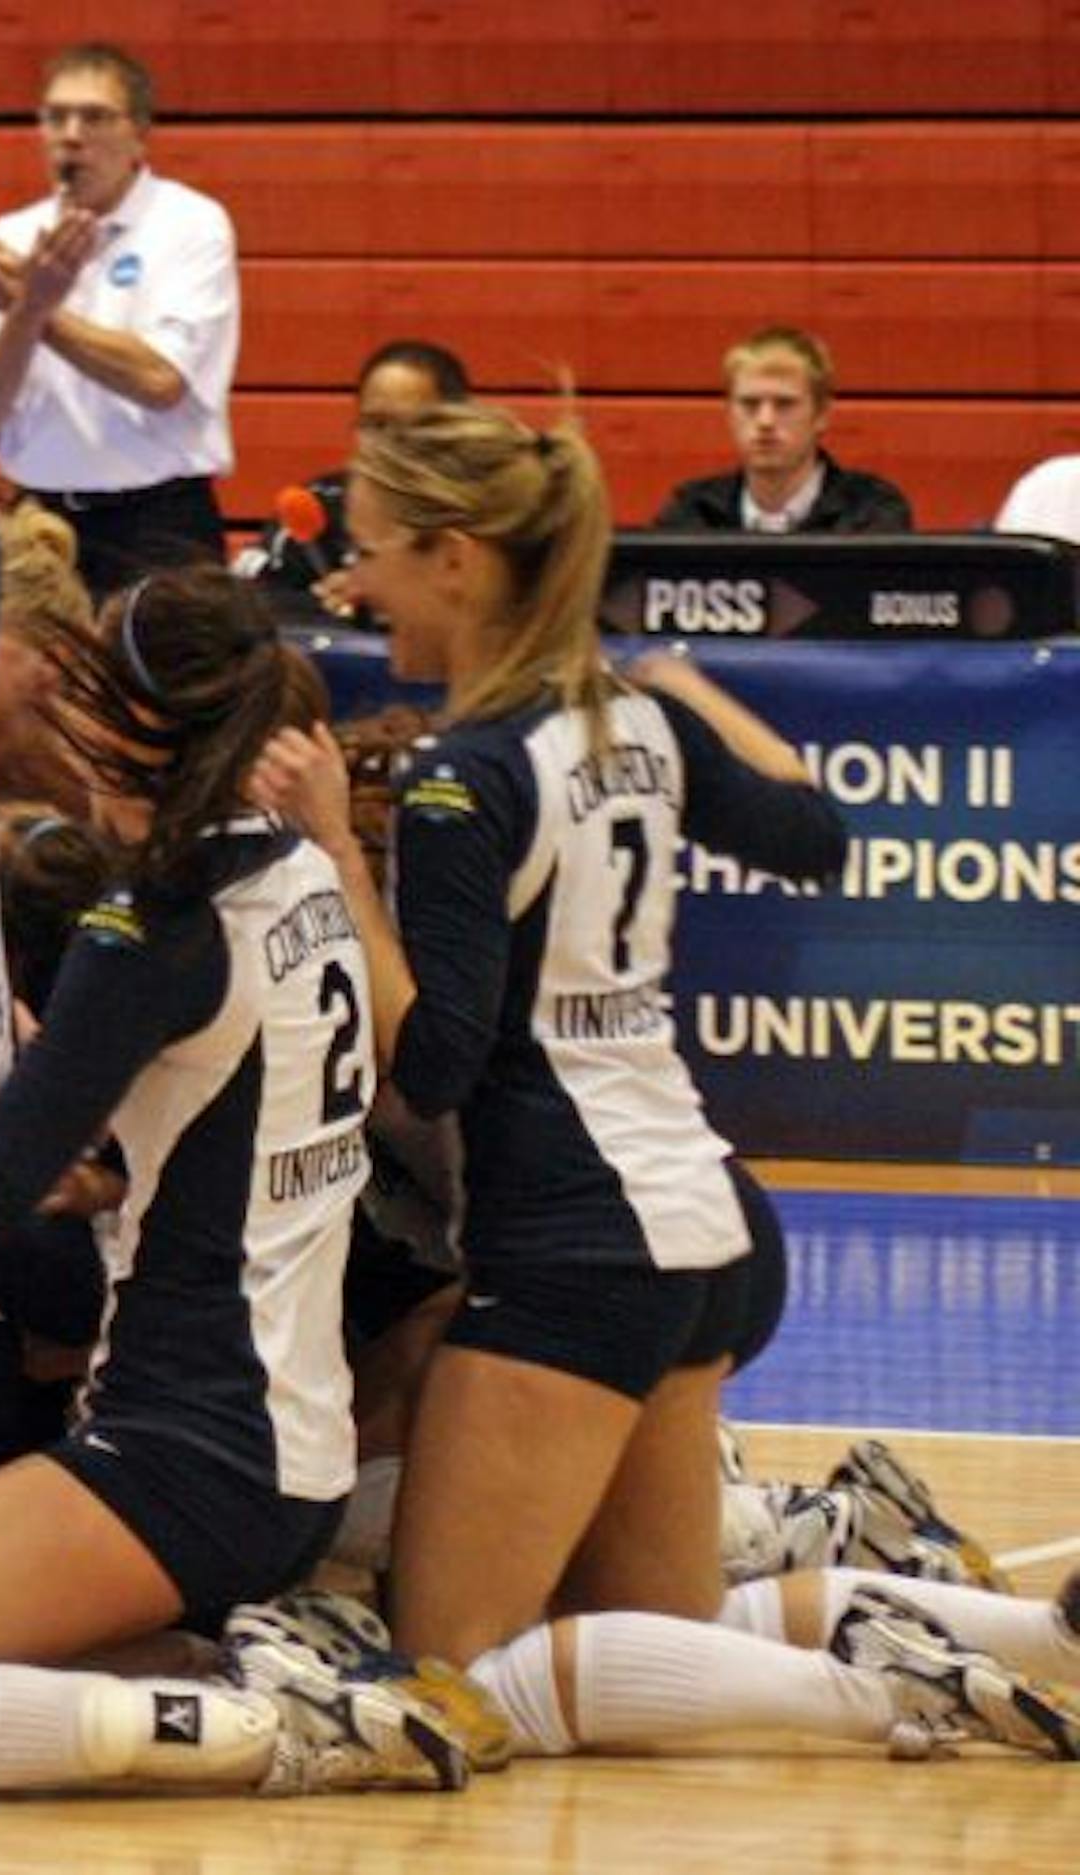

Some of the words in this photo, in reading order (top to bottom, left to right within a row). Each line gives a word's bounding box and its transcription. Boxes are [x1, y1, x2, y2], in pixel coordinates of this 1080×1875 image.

[644, 578, 765, 632] POSS
[967, 746, 1012, 808] II
[608, 815, 649, 973] 7
[318, 959, 366, 1125] 2
